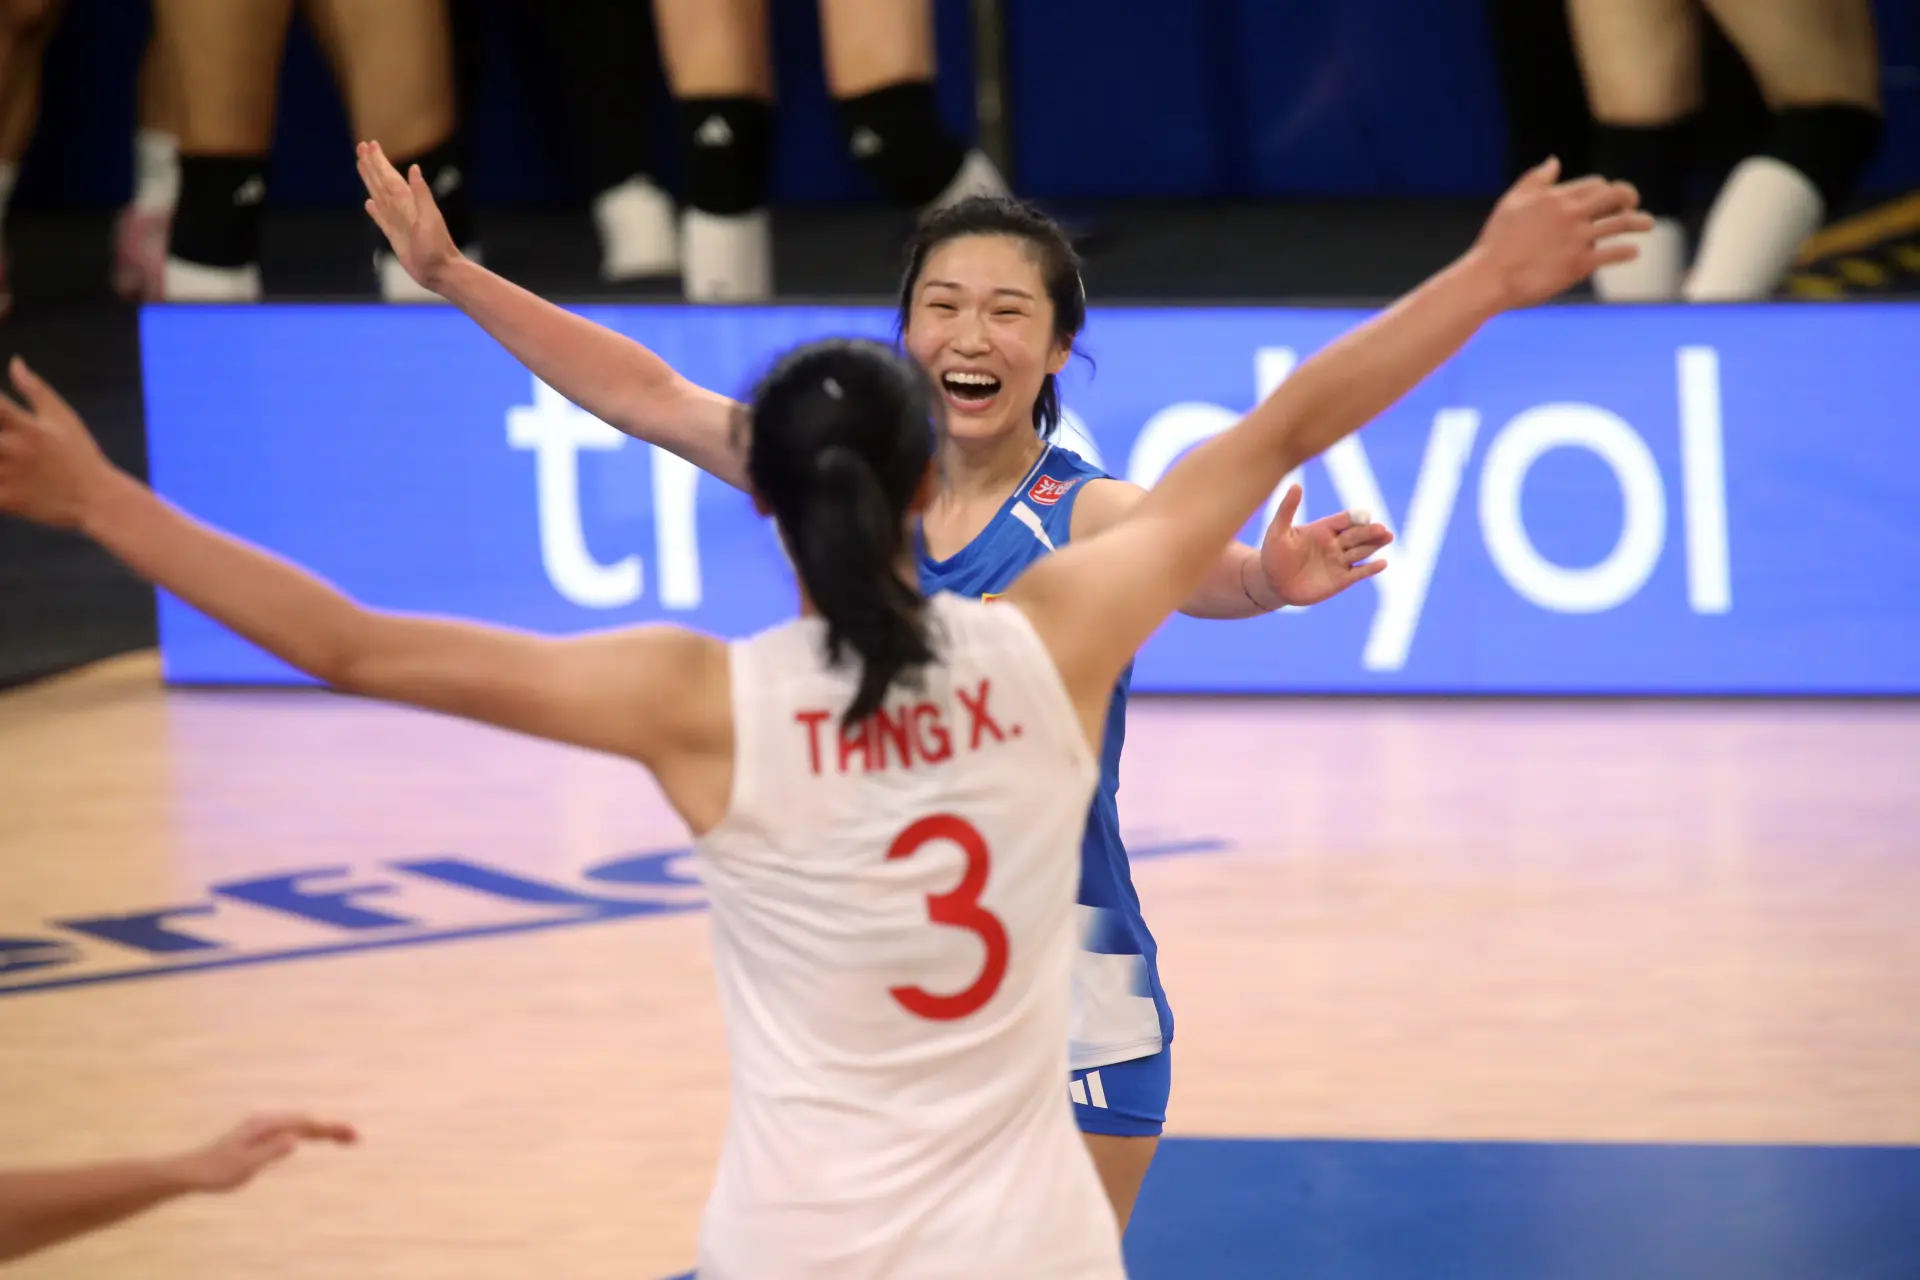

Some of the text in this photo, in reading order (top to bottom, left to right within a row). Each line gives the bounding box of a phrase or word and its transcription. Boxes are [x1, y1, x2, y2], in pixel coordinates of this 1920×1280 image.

[795, 679, 1022, 775] TANG X.
[885, 813, 1009, 1021] 3
